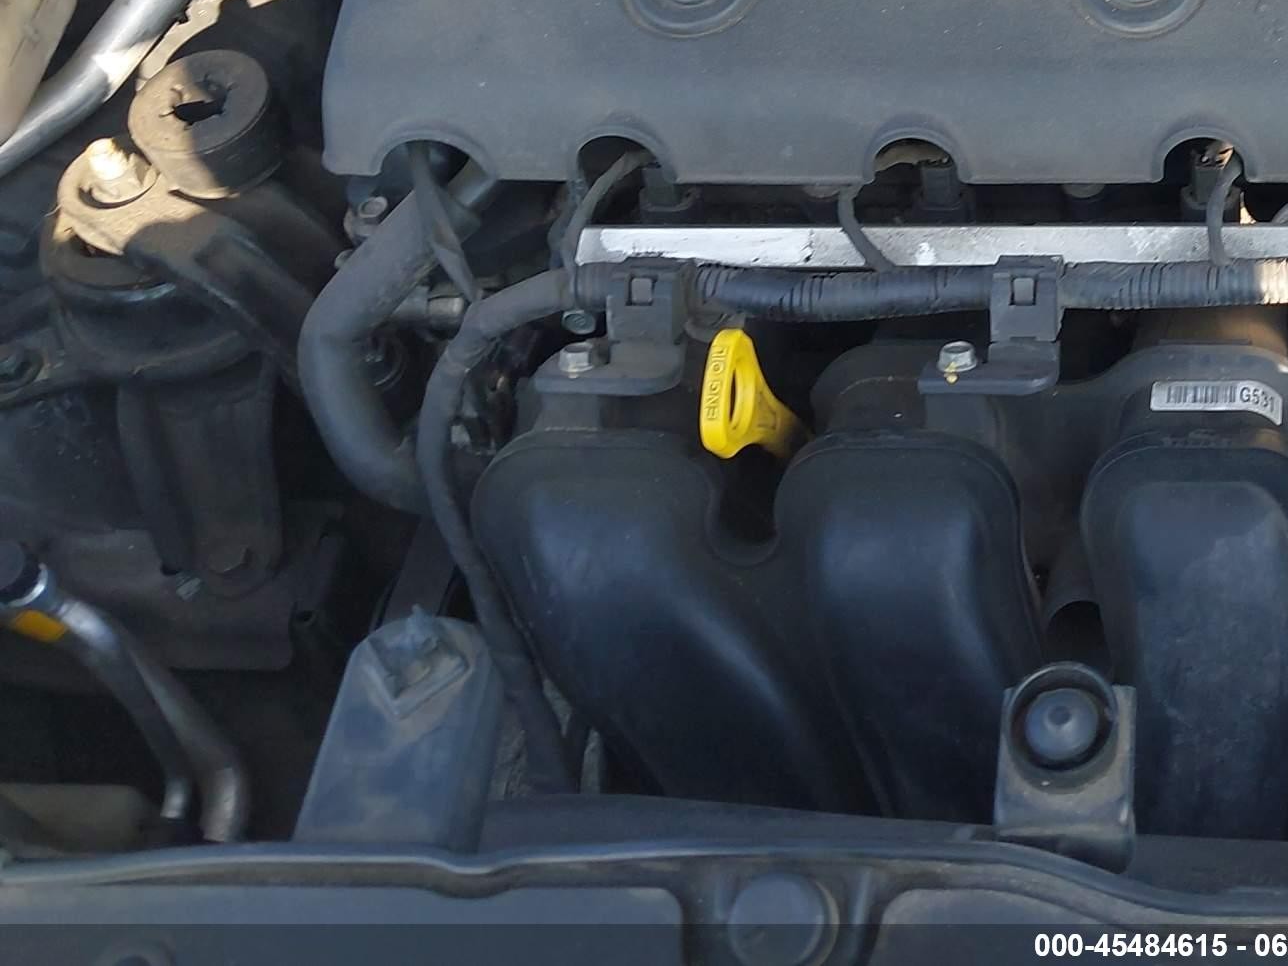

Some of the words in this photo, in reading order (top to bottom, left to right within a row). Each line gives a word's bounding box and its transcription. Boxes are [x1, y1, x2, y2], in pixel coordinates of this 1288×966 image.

[704, 380, 720, 421] ENG
[712, 346, 728, 375] OIL
[1239, 386, 1275, 414] G531
